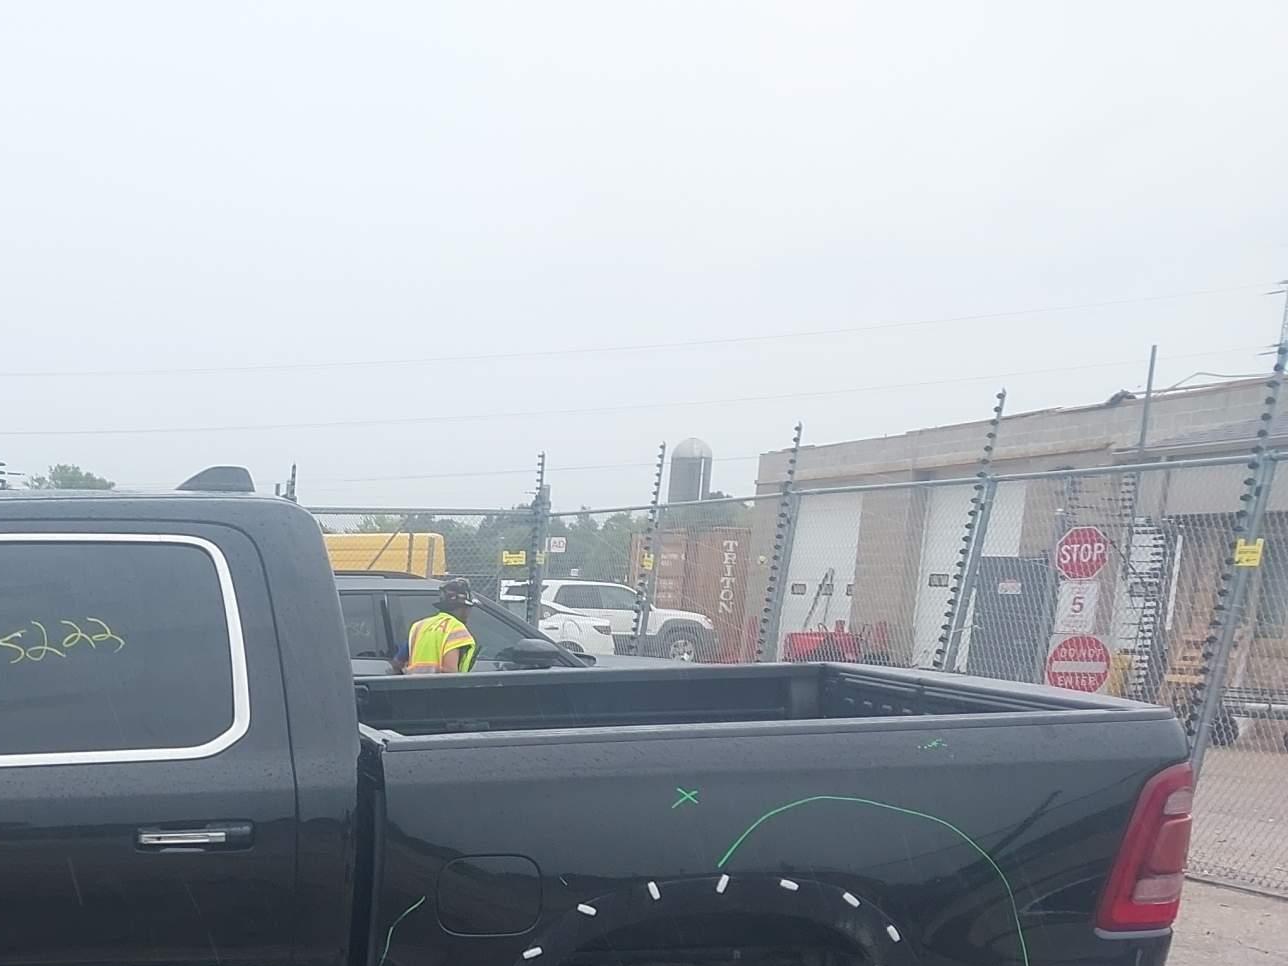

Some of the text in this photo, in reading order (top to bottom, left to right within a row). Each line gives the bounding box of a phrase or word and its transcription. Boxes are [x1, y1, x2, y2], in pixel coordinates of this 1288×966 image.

[1060, 543, 1105, 563] STOP
[718, 540, 738, 613] TRITON
[1072, 596, 1085, 614] 5
[1060, 647, 1104, 659] DO NOT
[1058, 675, 1099, 688] ENTER
